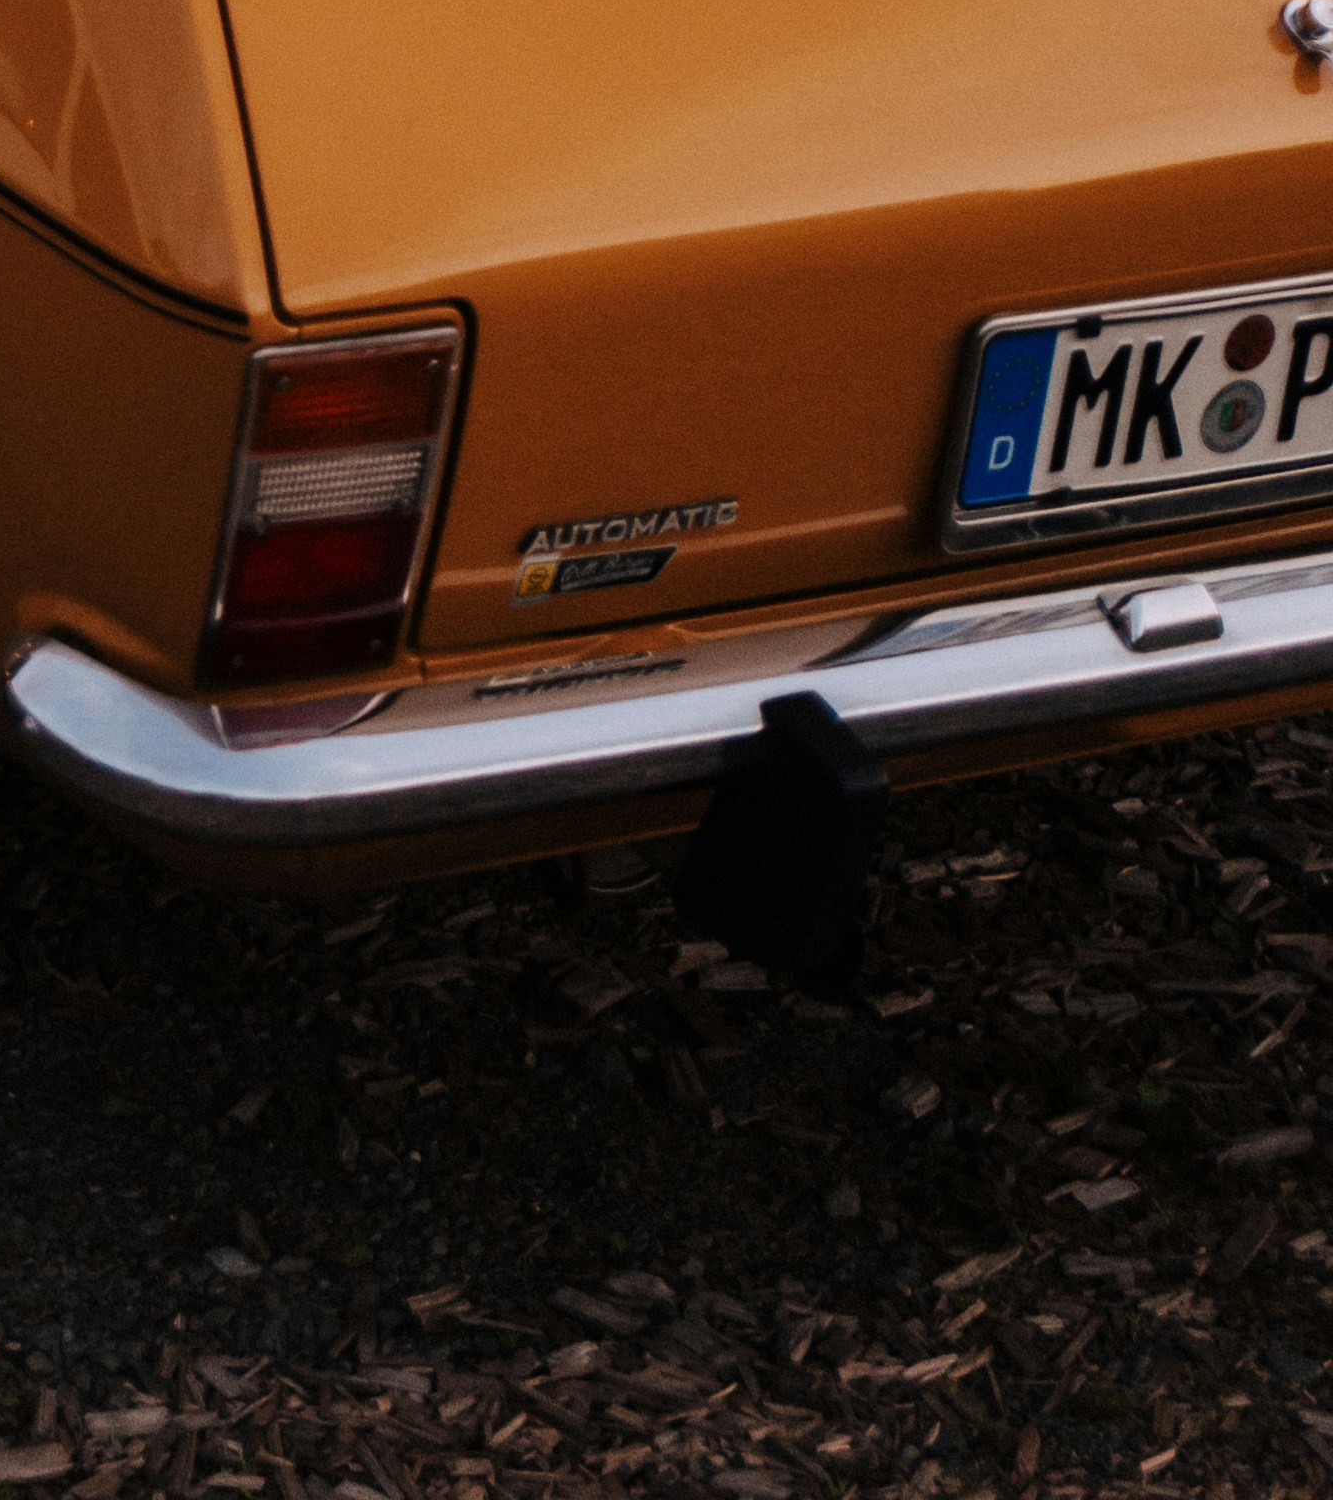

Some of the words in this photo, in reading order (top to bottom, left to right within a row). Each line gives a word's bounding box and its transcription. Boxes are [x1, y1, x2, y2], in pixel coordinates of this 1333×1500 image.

[1048, 334, 1204, 473] MK
[1276, 316, 1333, 442] P
[988, 435, 1015, 470] D
[523, 500, 740, 557] AUTOMATIC
